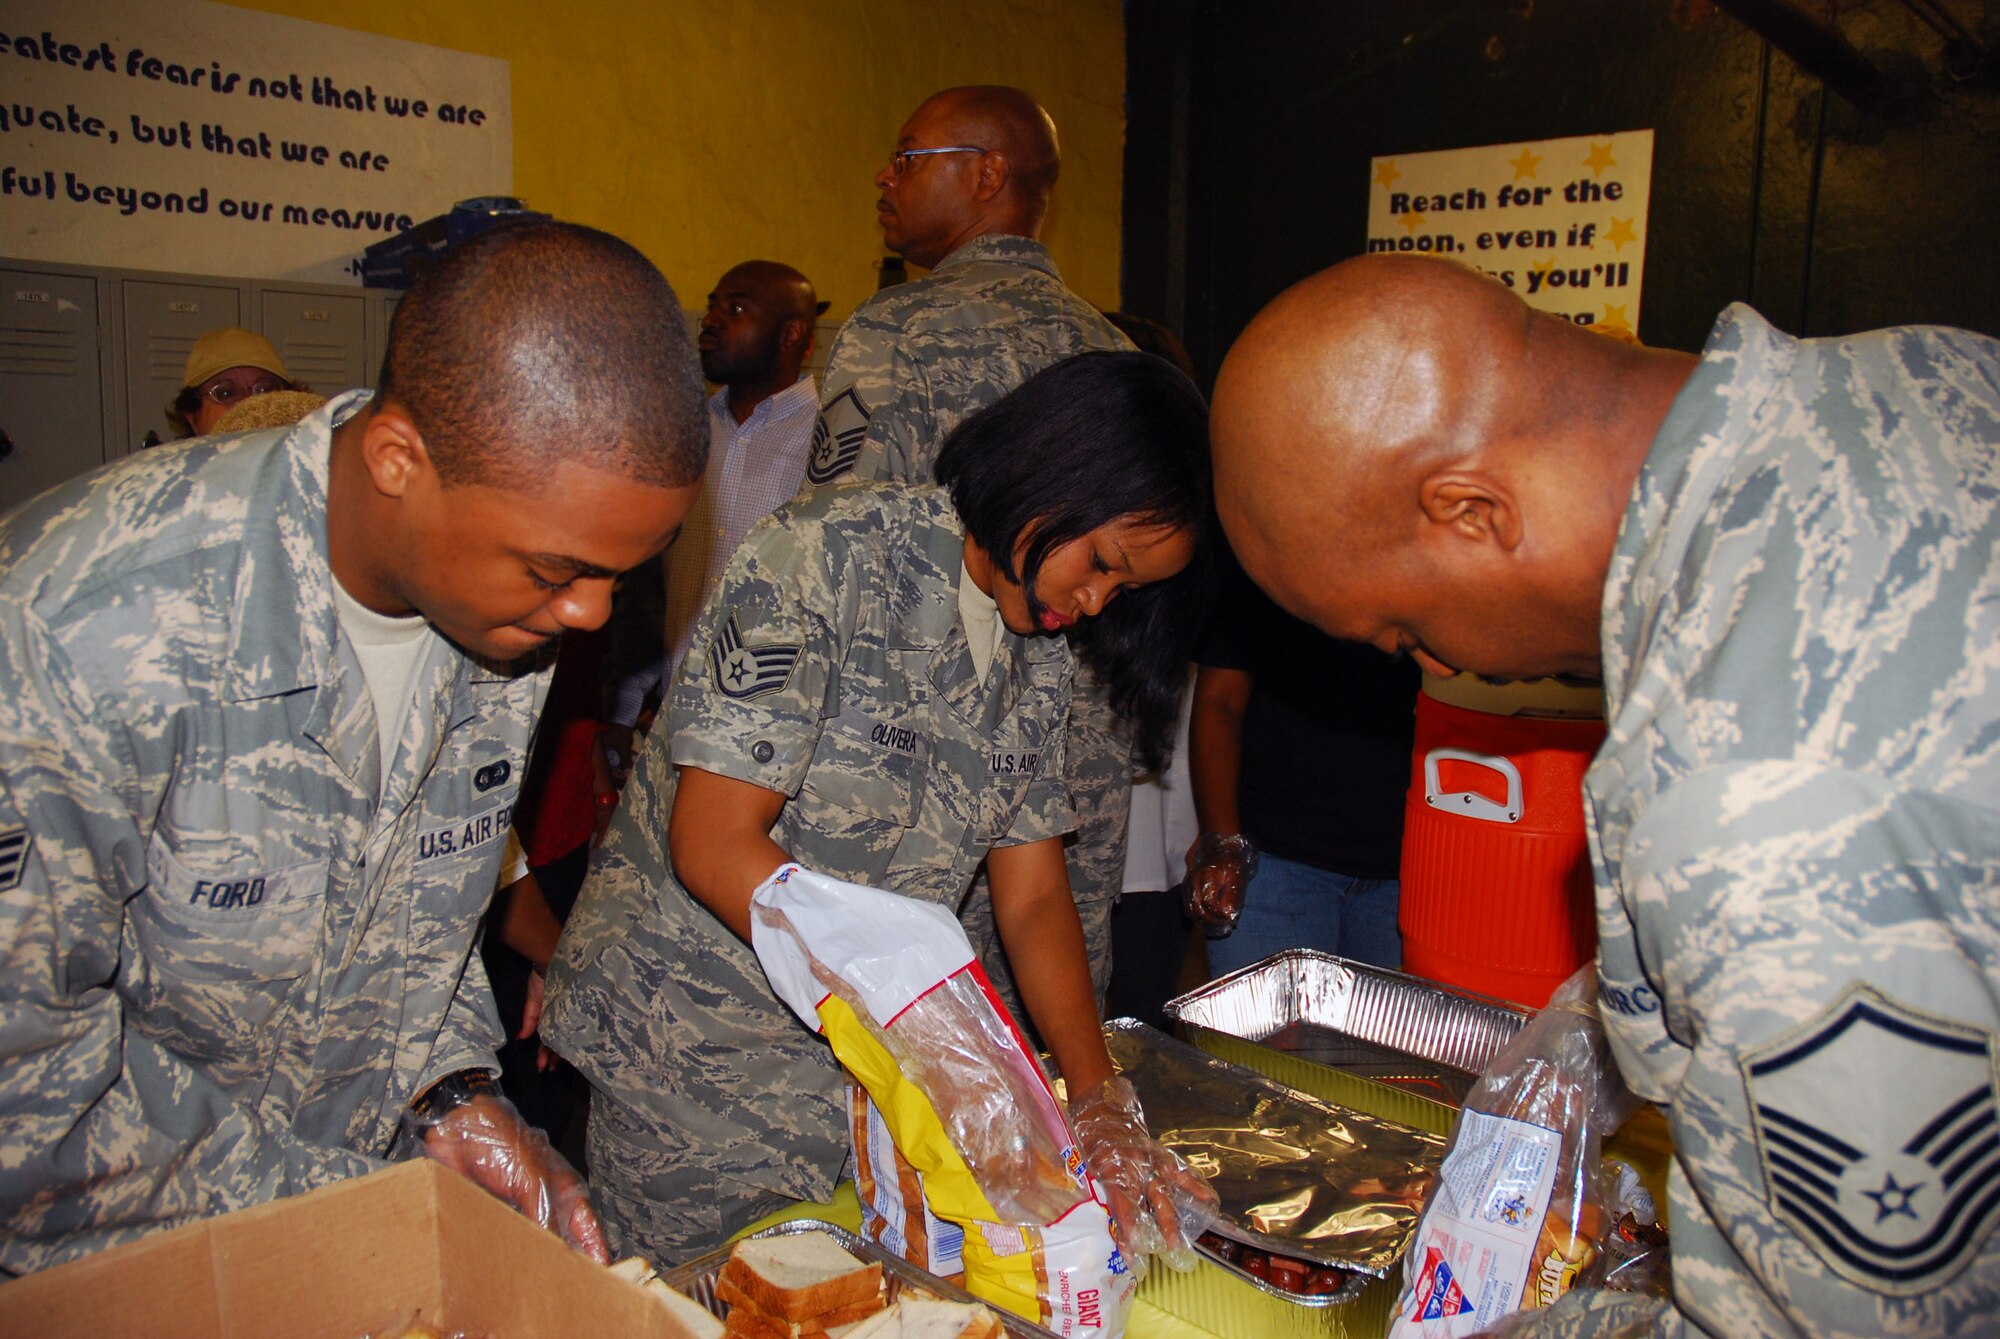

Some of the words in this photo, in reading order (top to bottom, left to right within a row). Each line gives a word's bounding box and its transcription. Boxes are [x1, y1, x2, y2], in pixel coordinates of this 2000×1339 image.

[126, 48, 205, 87] fear
[211, 61, 240, 94] is
[249, 73, 302, 102] not
[312, 76, 375, 112] that
[384, 95, 428, 118] we
[437, 103, 486, 126] are
[131, 114, 191, 150] but
[202, 123, 271, 159] that
[281, 141, 329, 166] we
[339, 150, 389, 172] are
[2, 166, 55, 200] ful
[65, 171, 208, 216] beyond
[219, 198, 273, 222] our
[283, 204, 413, 232] measure
[1390, 188, 1486, 214] Reach
[1498, 184, 1552, 208] for
[1564, 179, 1622, 203] the
[1368, 234, 1465, 253] moon,
[1477, 229, 1556, 250] even
[1567, 223, 1596, 247] if
[1527, 262, 1629, 294] you'll
[871, 723, 917, 753] OLIVERA
[992, 752, 1016, 773] U.S.
[1018, 753, 1038, 773] AIR
[419, 830, 457, 860] U.S.
[462, 815, 492, 850] AIR
[189, 878, 265, 909] FORD
[1600, 986, 1658, 1015] ORC
[1541, 1256, 1566, 1305] BUTT
[1077, 1289, 1101, 1328] GIANT
[1062, 1318, 1072, 1338] BRE
